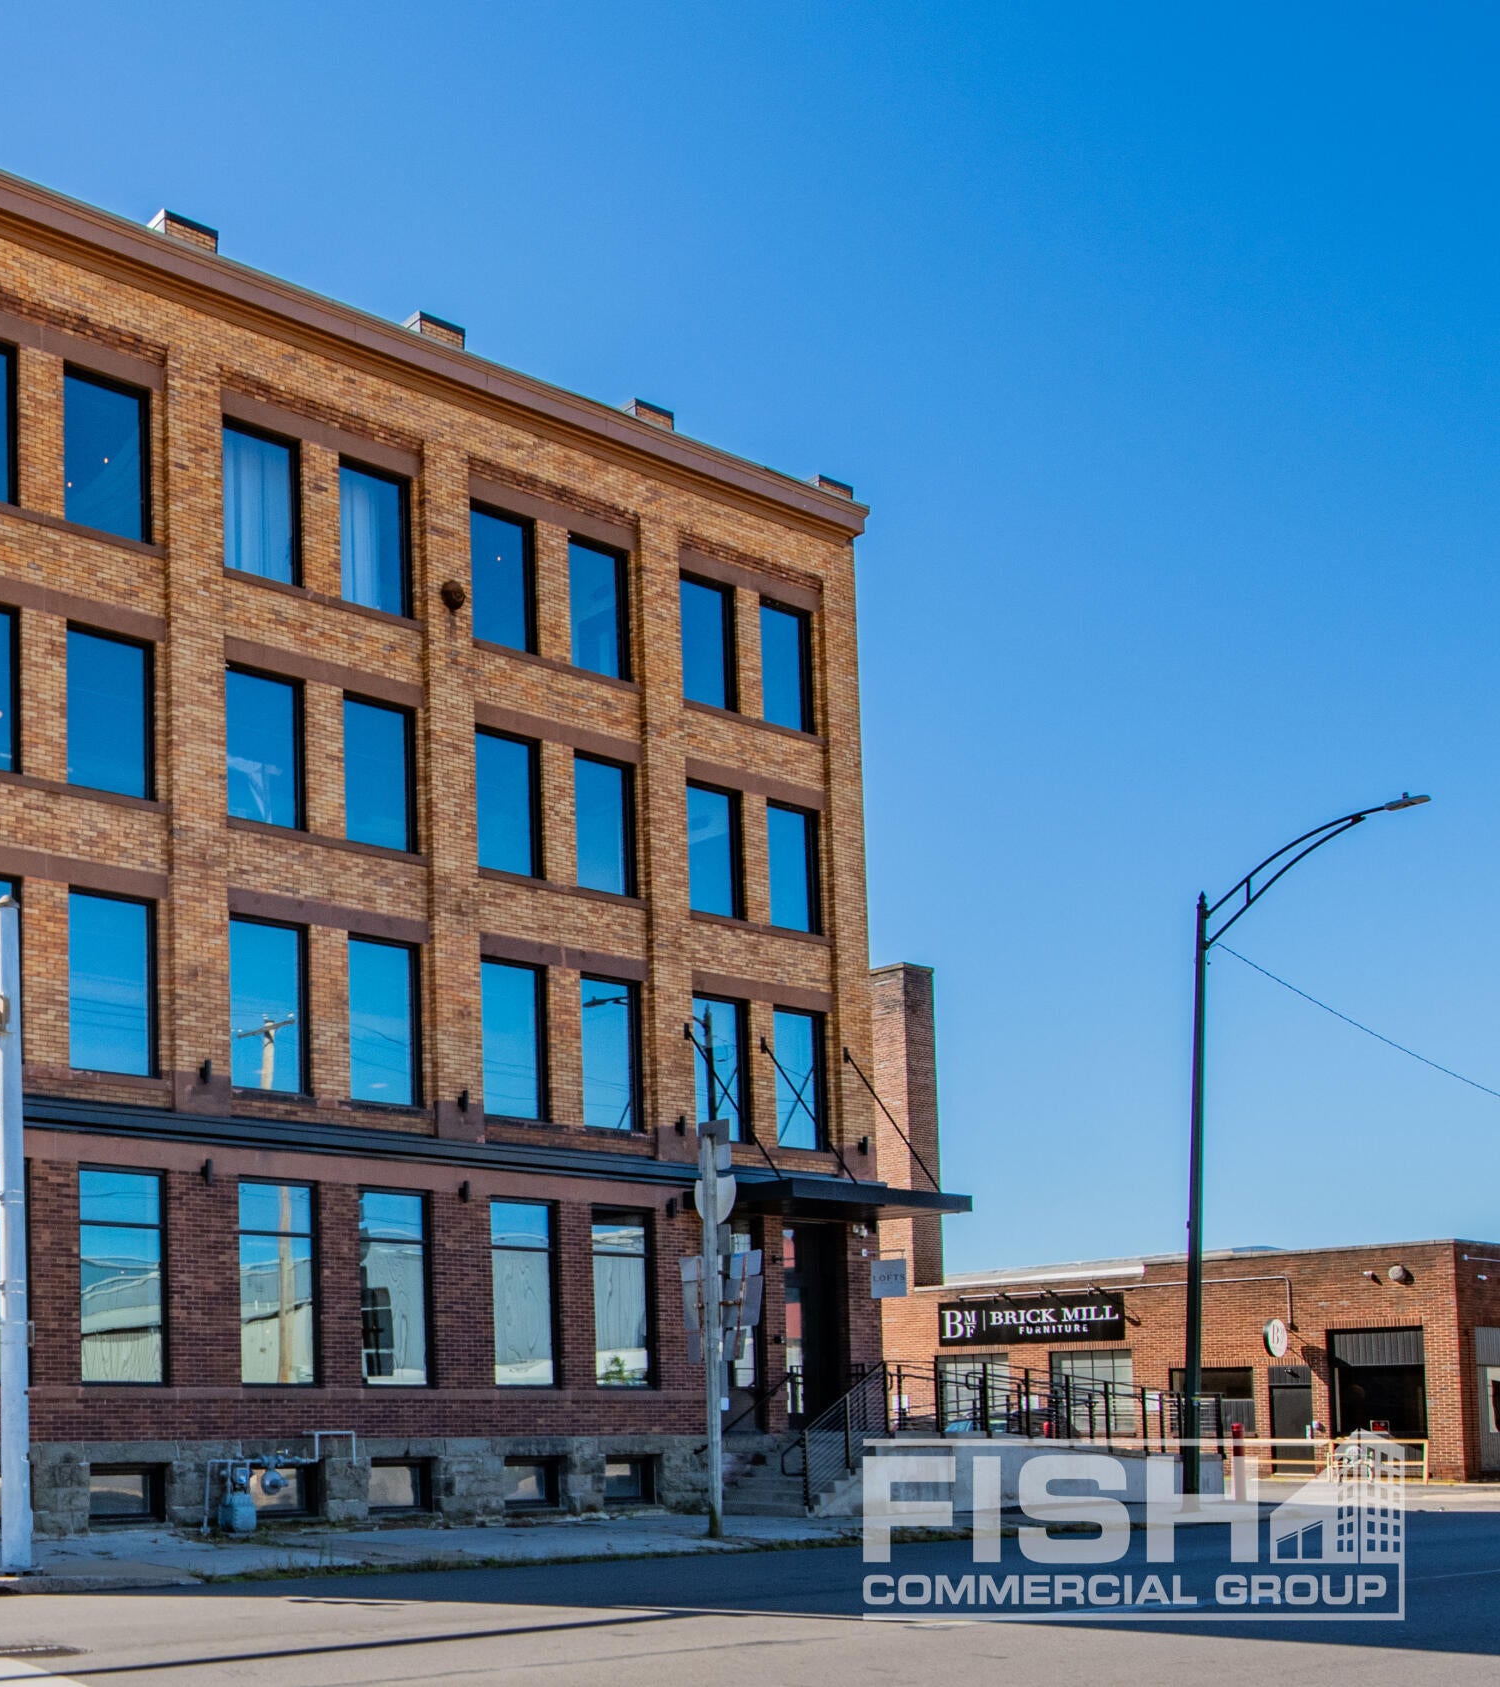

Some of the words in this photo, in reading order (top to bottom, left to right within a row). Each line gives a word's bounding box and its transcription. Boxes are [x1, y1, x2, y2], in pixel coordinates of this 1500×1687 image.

[873, 1273, 906, 1282] LOFTS
[990, 1308, 1057, 1325] BRICK
[1061, 1305, 1119, 1322] MILL
[1018, 1323, 1090, 1335] FURNITURE
